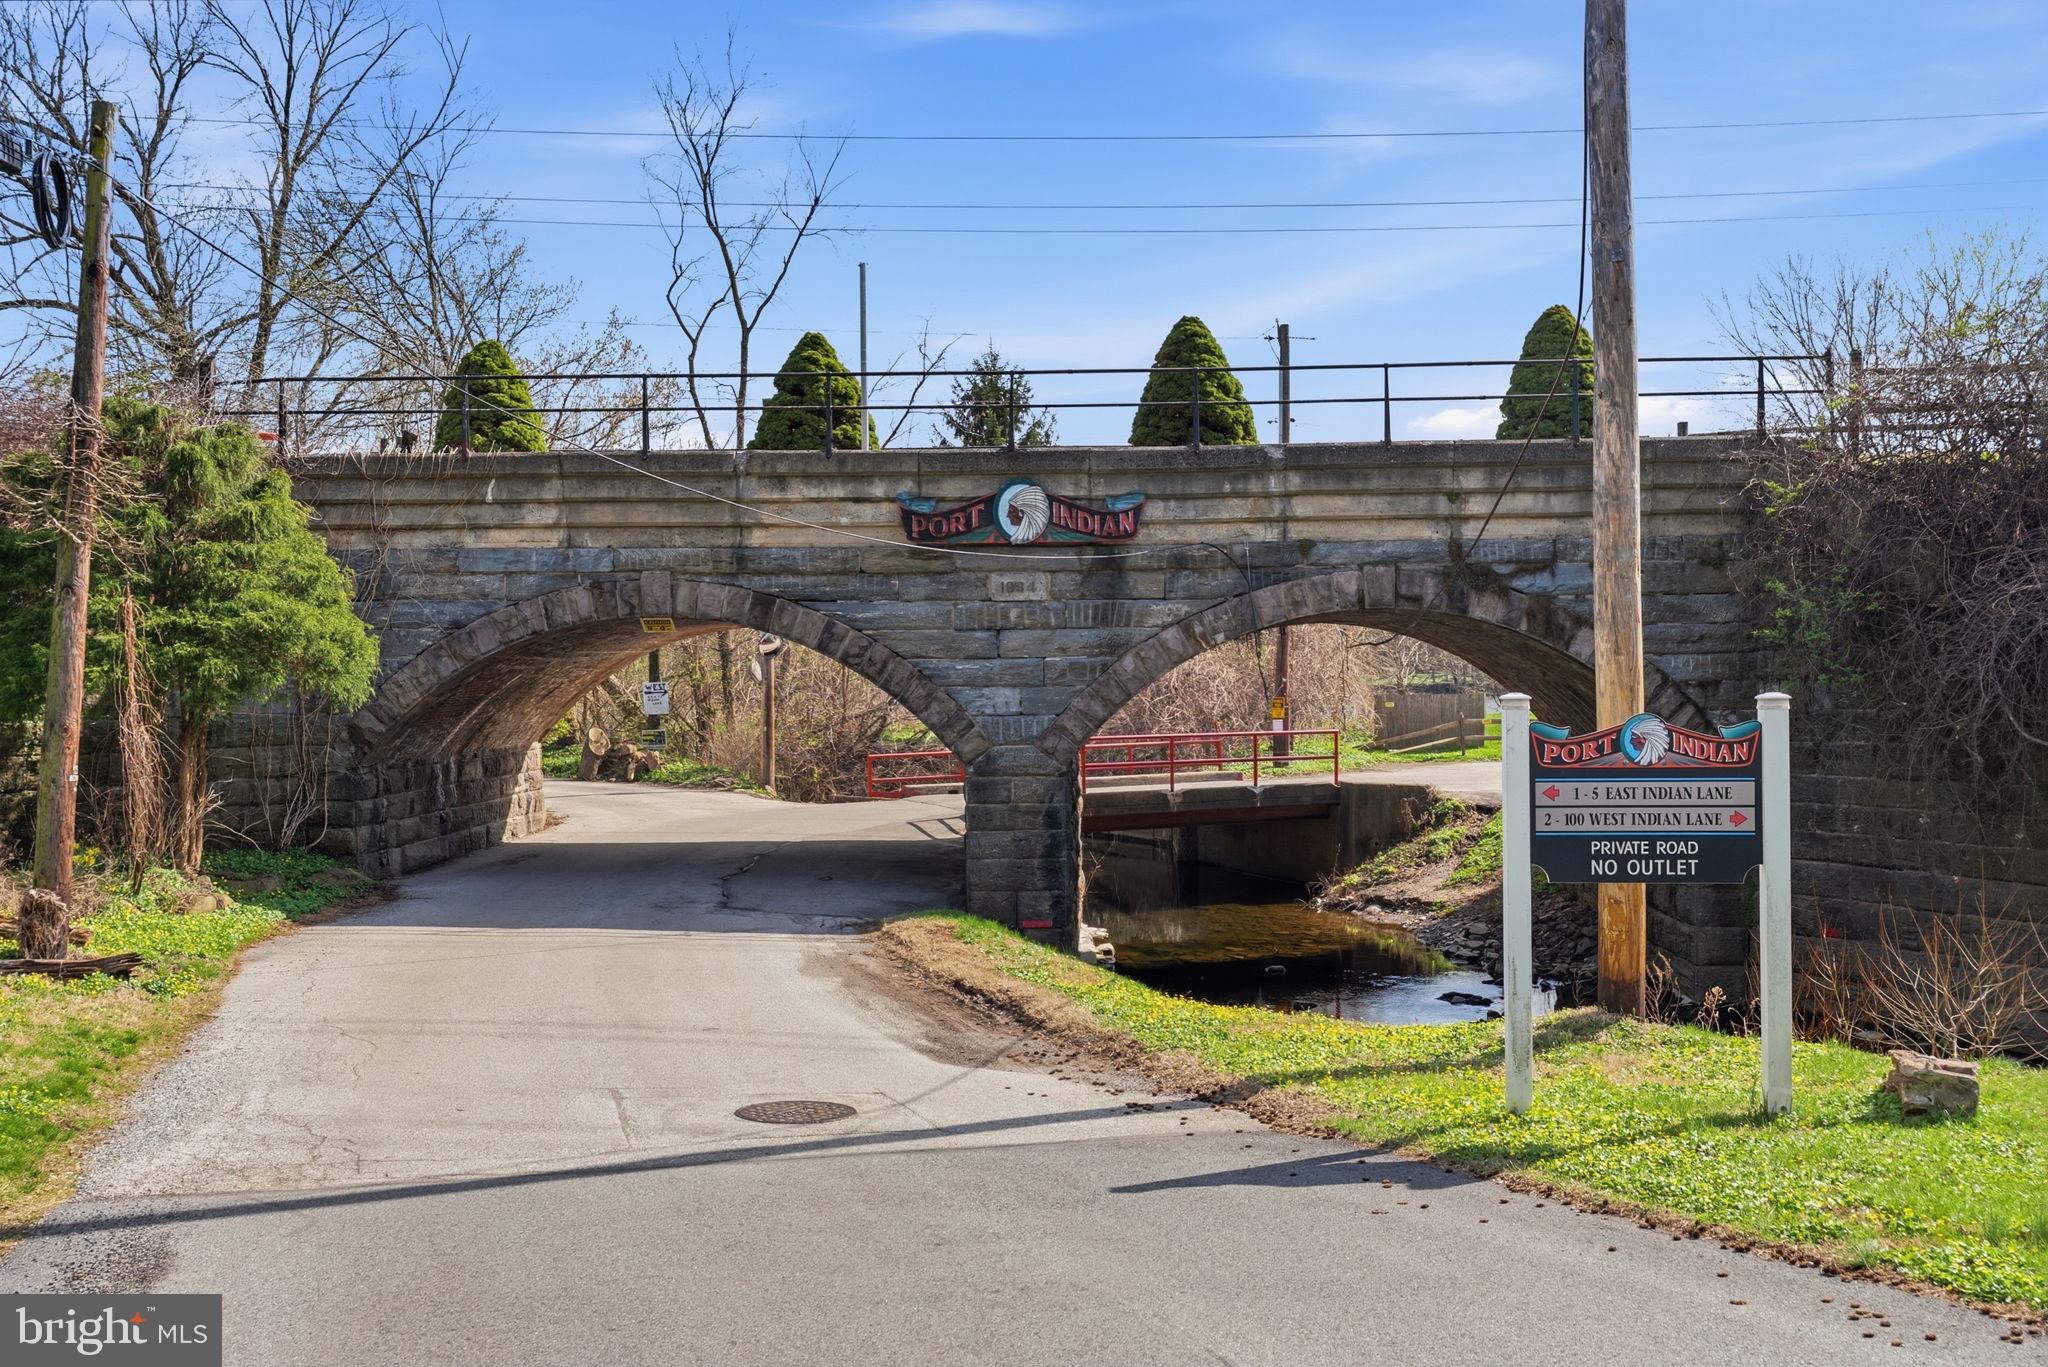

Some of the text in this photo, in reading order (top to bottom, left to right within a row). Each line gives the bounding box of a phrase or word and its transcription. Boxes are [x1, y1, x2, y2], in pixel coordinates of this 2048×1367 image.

[911, 500, 1135, 539] PORT INDIAN
[645, 683, 666, 691] WEST
[1542, 731, 1751, 763] PORT INDIAN
[1574, 787, 1580, 800] 1
[1591, 787, 1599, 800] 5
[1606, 787, 1639, 800] EAST
[1642, 787, 1693, 800] INDIAN
[1697, 787, 1733, 800] LANE
[1544, 813, 1552, 826] 2
[1564, 813, 1585, 826] 100
[1589, 813, 1627, 826] WEST
[1631, 813, 1682, 826] INDIAN
[1686, 813, 1723, 826] LANE
[1591, 841, 1699, 855] PRIVATE ROAD
[1591, 859, 1699, 876] NO OUTLET
